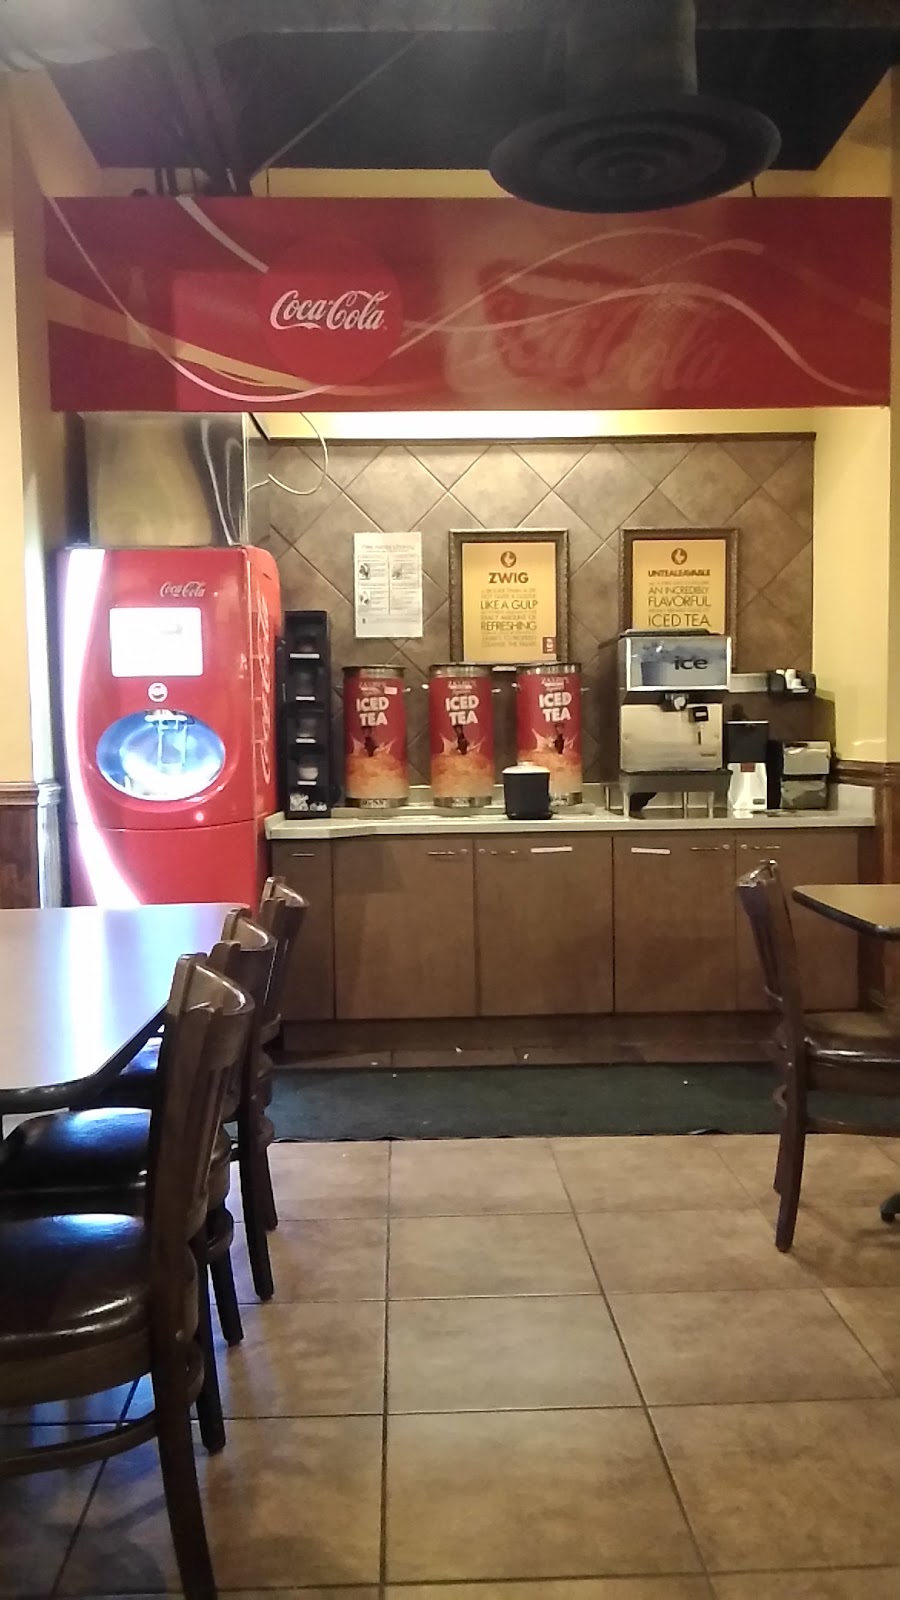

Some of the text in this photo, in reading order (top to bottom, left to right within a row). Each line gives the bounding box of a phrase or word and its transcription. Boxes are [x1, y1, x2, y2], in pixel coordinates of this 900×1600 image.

[270, 289, 391, 331] Coca-Cola
[489, 572, 529, 584] ZWIG
[159, 581, 207, 598] Coca-Cola
[648, 586, 709, 594] AN INCREDIBLY
[480, 599, 538, 610] LIKE A GULP
[648, 595, 712, 607] FLAVORFUL
[480, 620, 537, 631] REFRESHING
[648, 613, 712, 628] ICED TEA
[675, 656, 708, 670] ice
[356, 696, 389, 711] ICED
[446, 695, 479, 710] ICED
[539, 692, 572, 707] ICED
[360, 711, 387, 726] TEA
[449, 710, 478, 725] TEA
[543, 707, 571, 722] TEA
